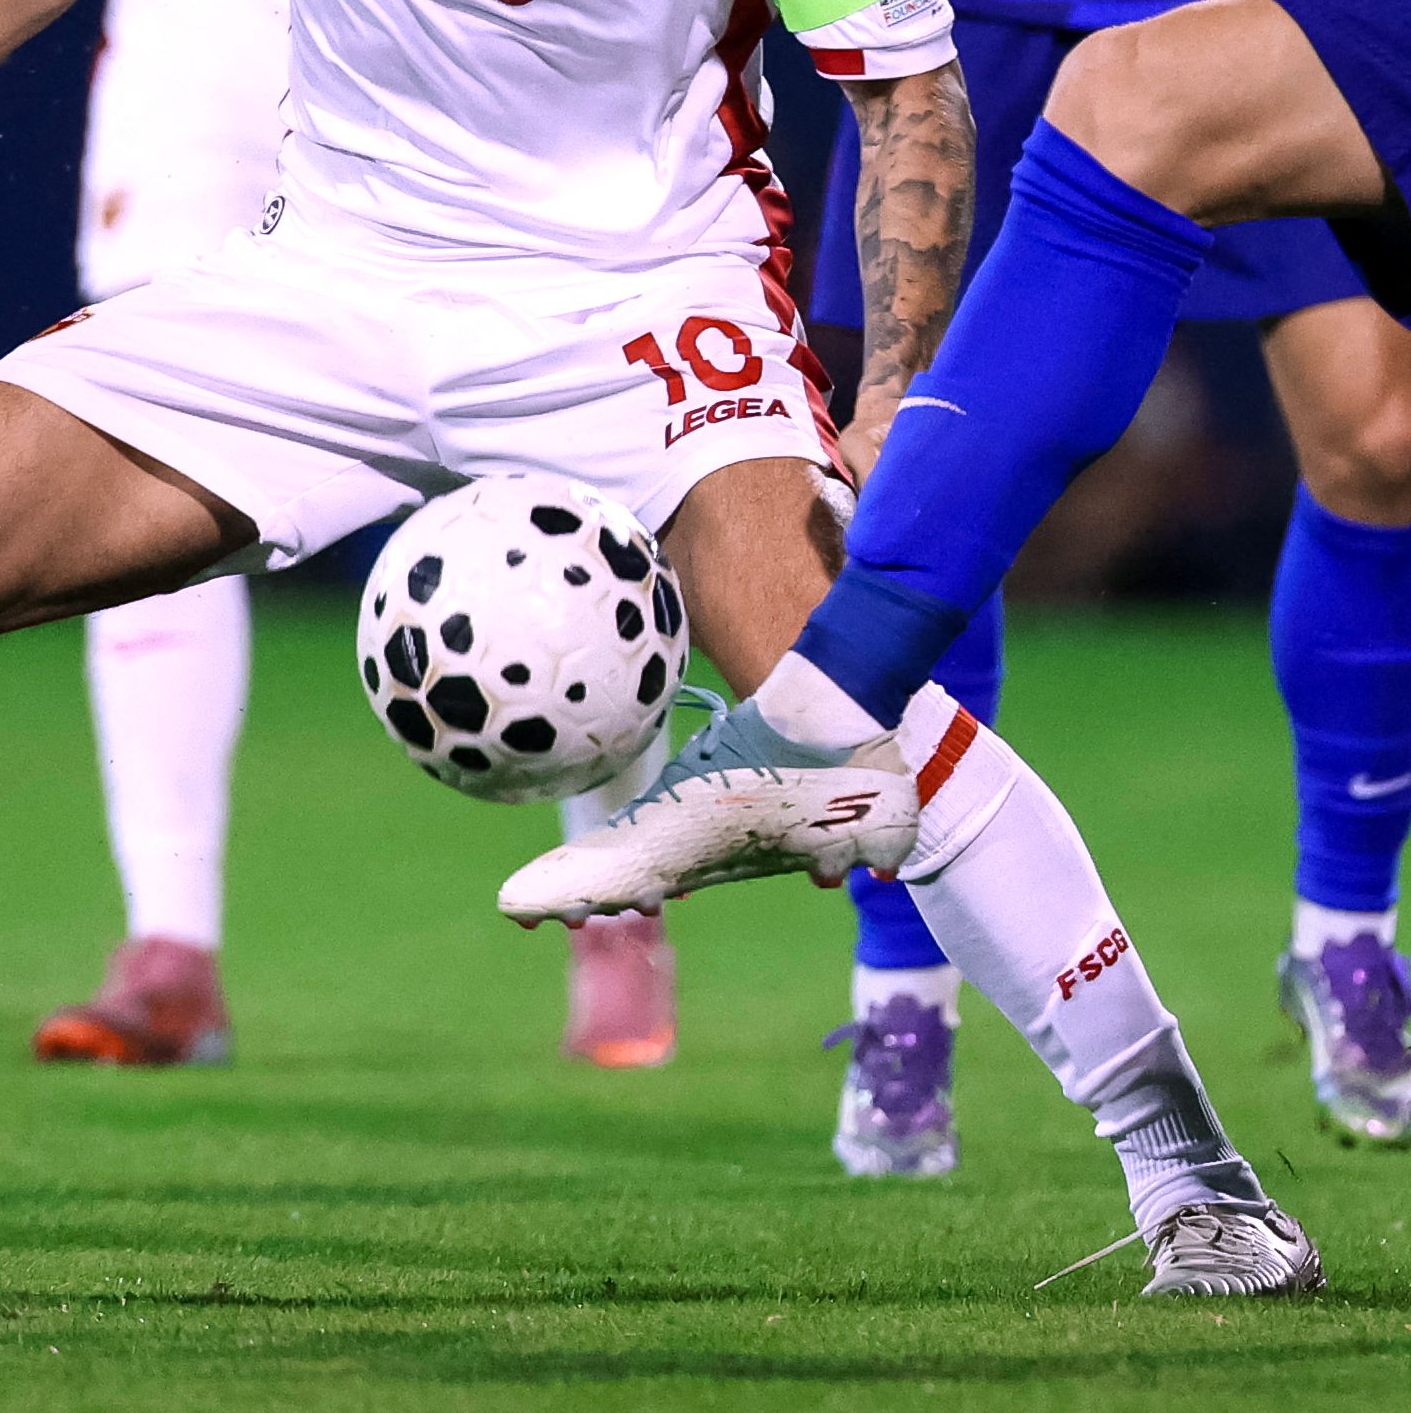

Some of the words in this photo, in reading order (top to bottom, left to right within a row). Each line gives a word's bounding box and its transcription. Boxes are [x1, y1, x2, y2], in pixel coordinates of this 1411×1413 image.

[622, 316, 763, 406] 10
[664, 398, 792, 450] LEGEA
[1056, 927, 1130, 1001] FSCG
